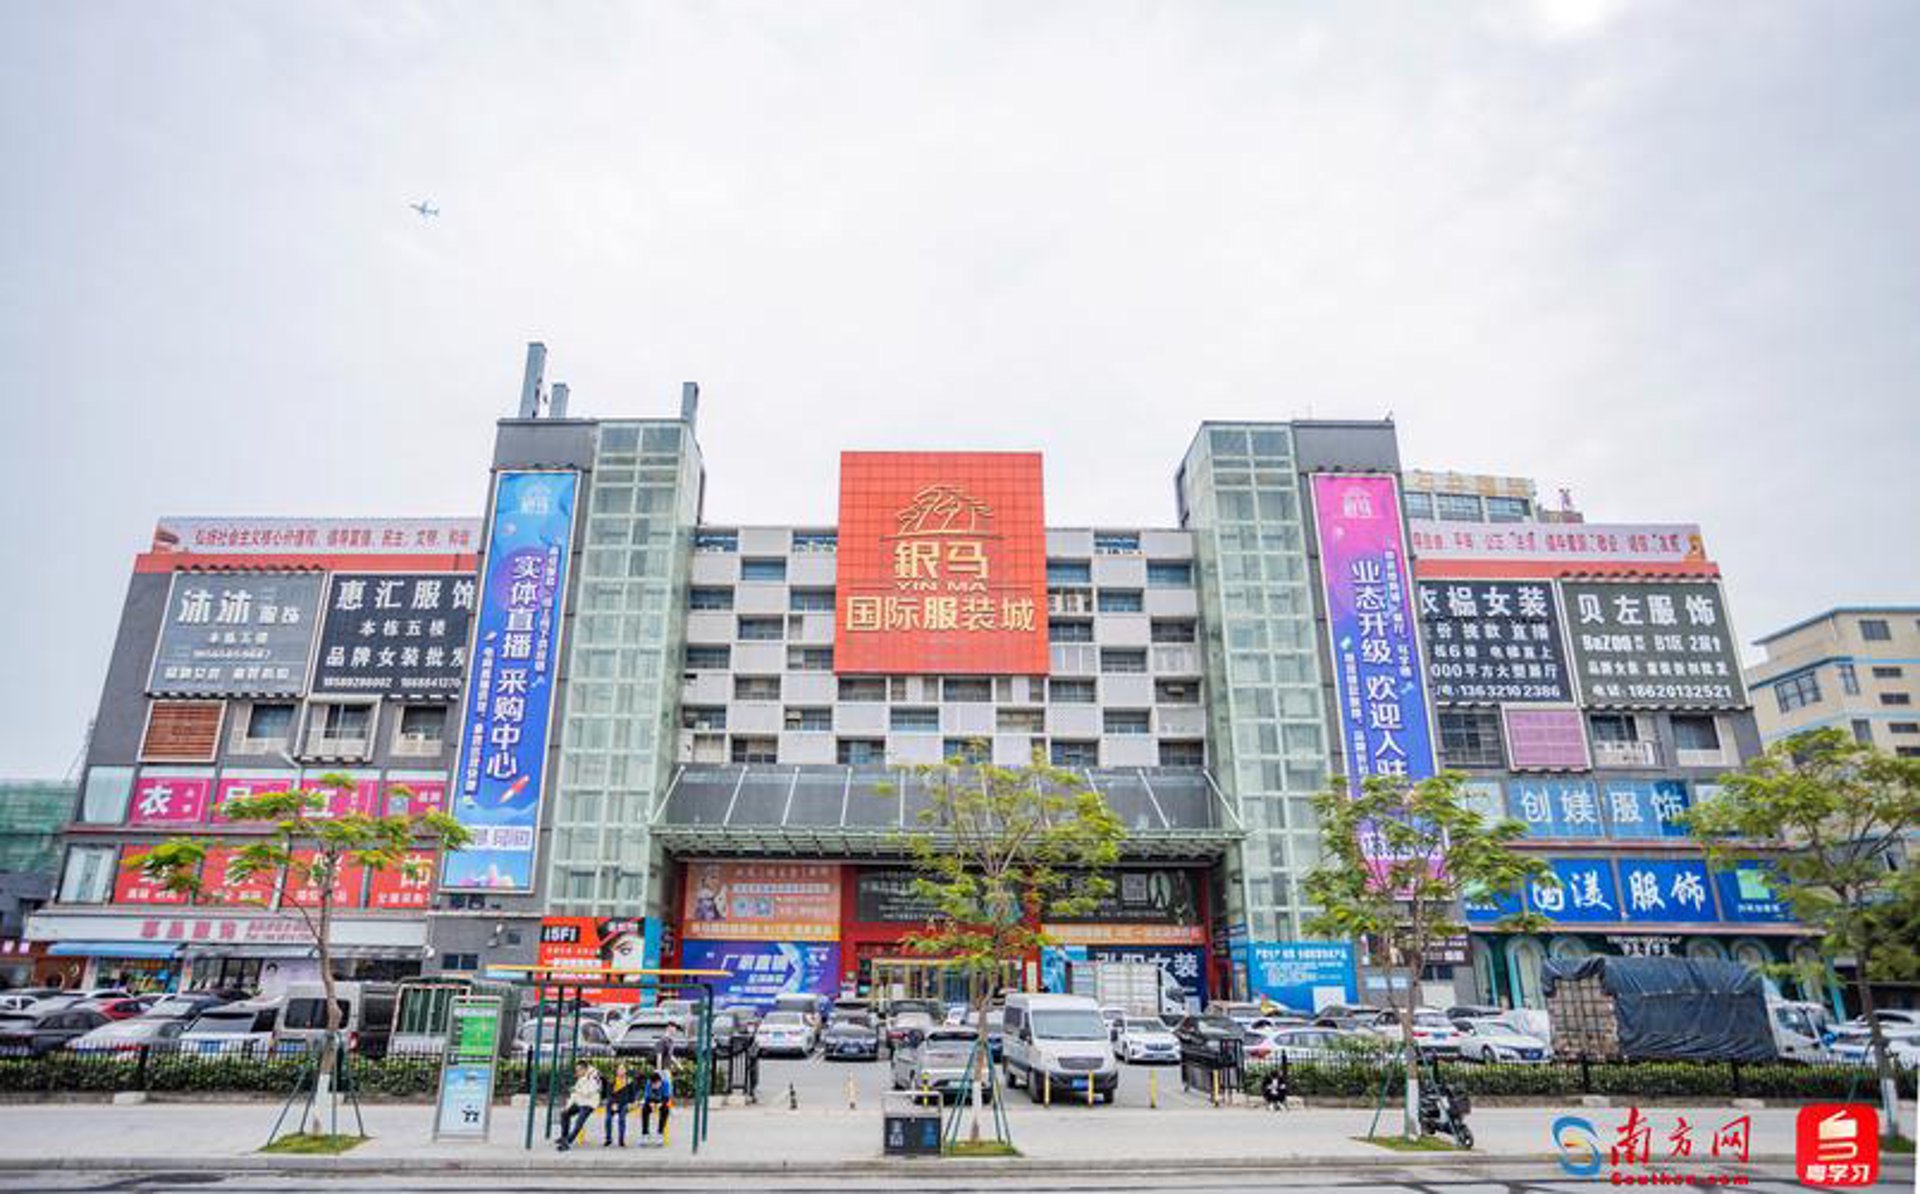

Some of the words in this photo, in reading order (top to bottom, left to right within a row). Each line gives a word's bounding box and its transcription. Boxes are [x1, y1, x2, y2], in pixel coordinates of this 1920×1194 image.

[500, 556, 542, 659] 实体直播
[845, 596, 1036, 631] 国际服装城
[897, 581, 938, 591] YIN
[947, 582, 987, 591] MA
[1352, 560, 1394, 664] 业态升级
[1577, 594, 1716, 626] 贝左服饰
[486, 668, 528, 778] 采购中心
